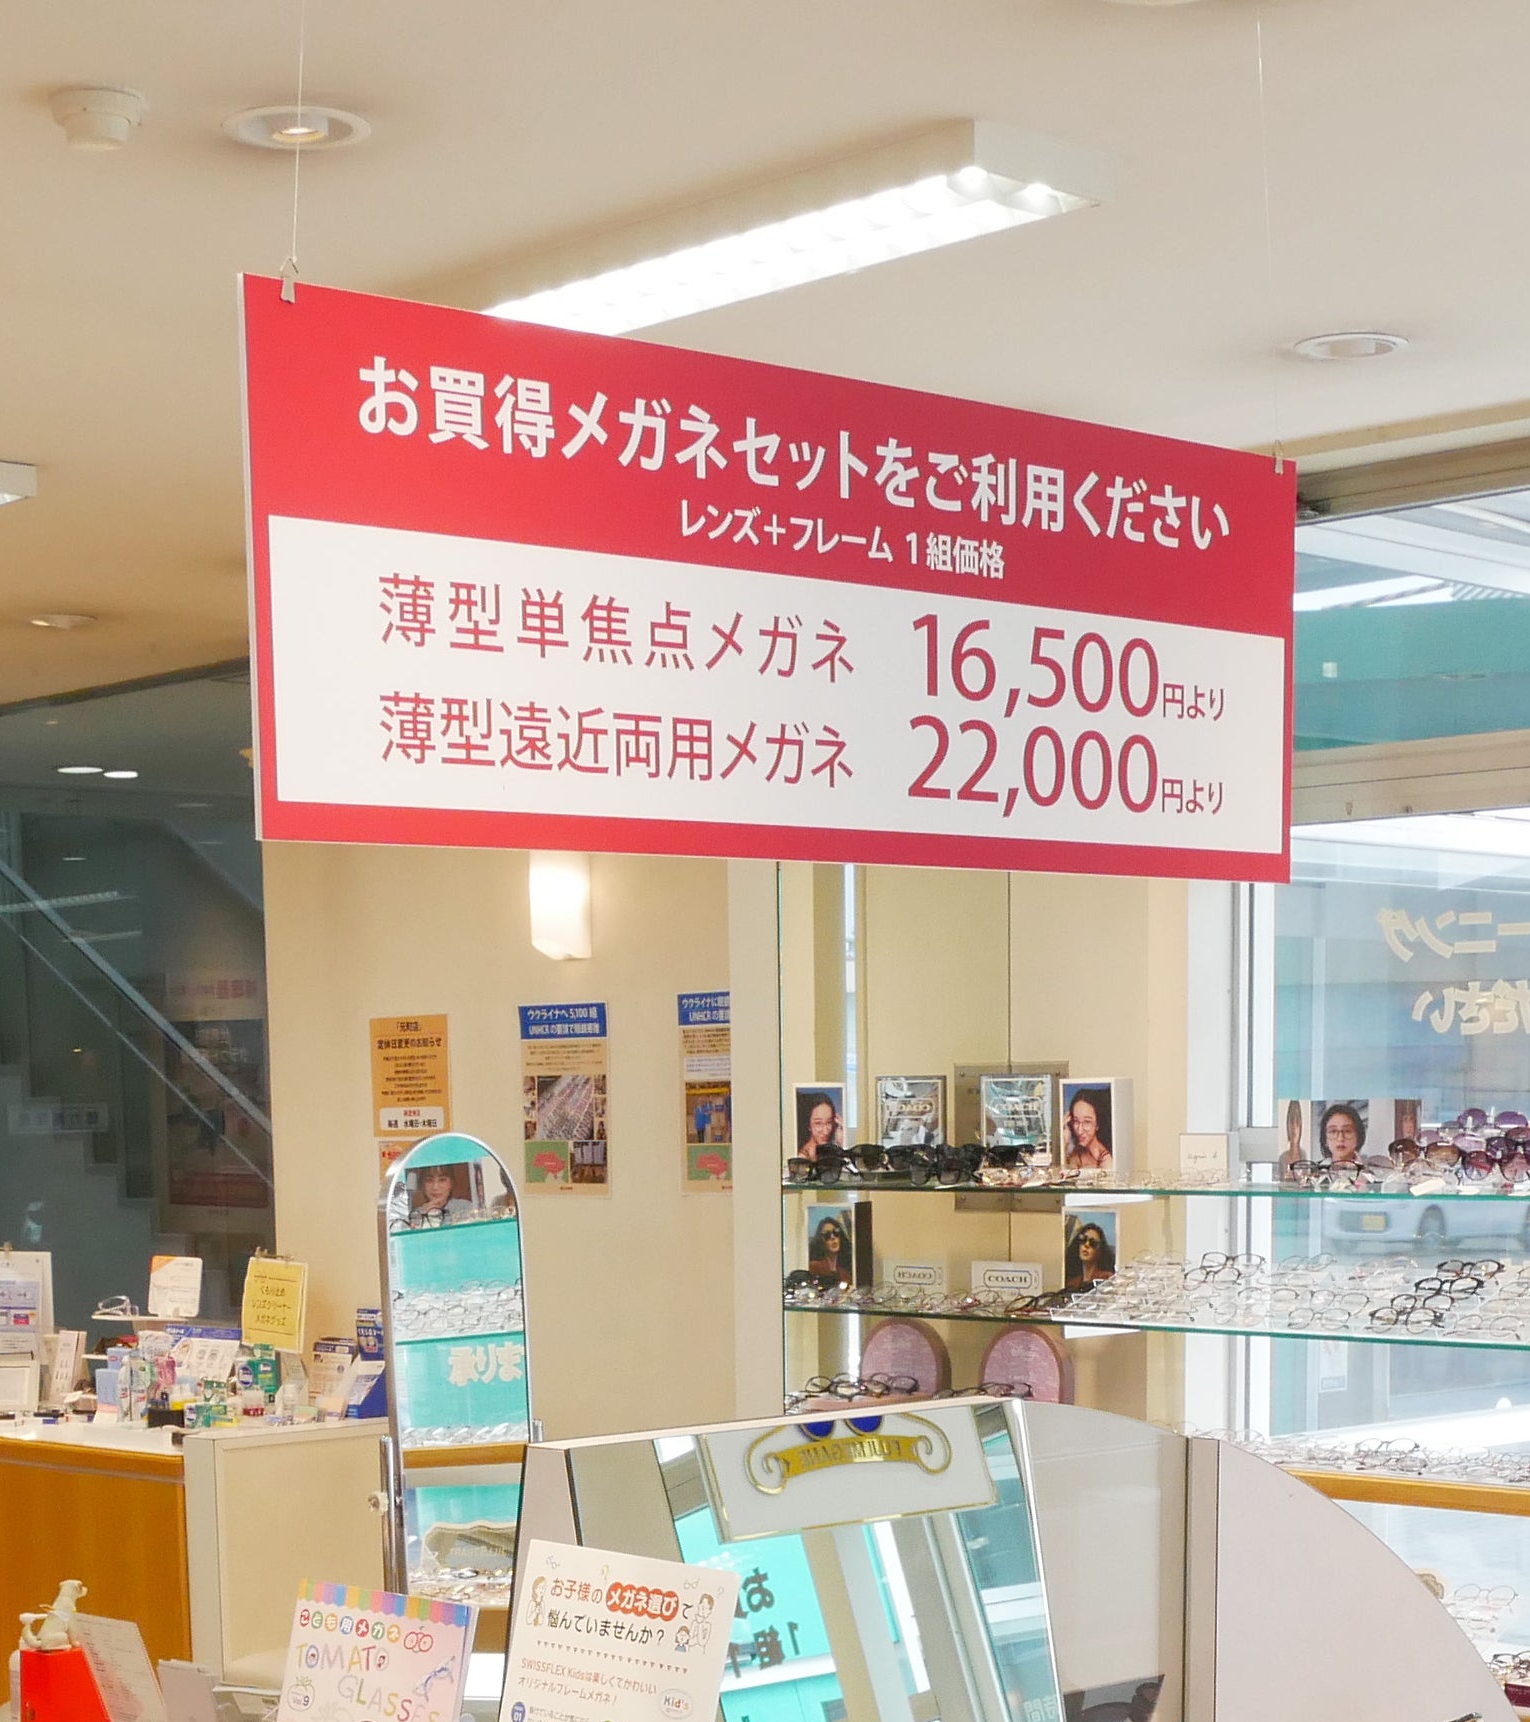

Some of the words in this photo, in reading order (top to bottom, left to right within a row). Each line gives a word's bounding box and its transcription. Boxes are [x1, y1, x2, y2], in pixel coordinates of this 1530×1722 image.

[358, 355, 1231, 551] お買得メガネセットをご利用ください
[379, 571, 855, 682] 薄型単焦点メガネ
[910, 611, 1224, 721] 16,500円より
[379, 690, 855, 787] 薄型遠近両用メガネ
[906, 714, 1224, 817] 22,000円より
[988, 1275, 1029, 1284] COACH
[296, 1643, 389, 1672] TOMATO
[300, 1609, 401, 1643] こども用メガネ
